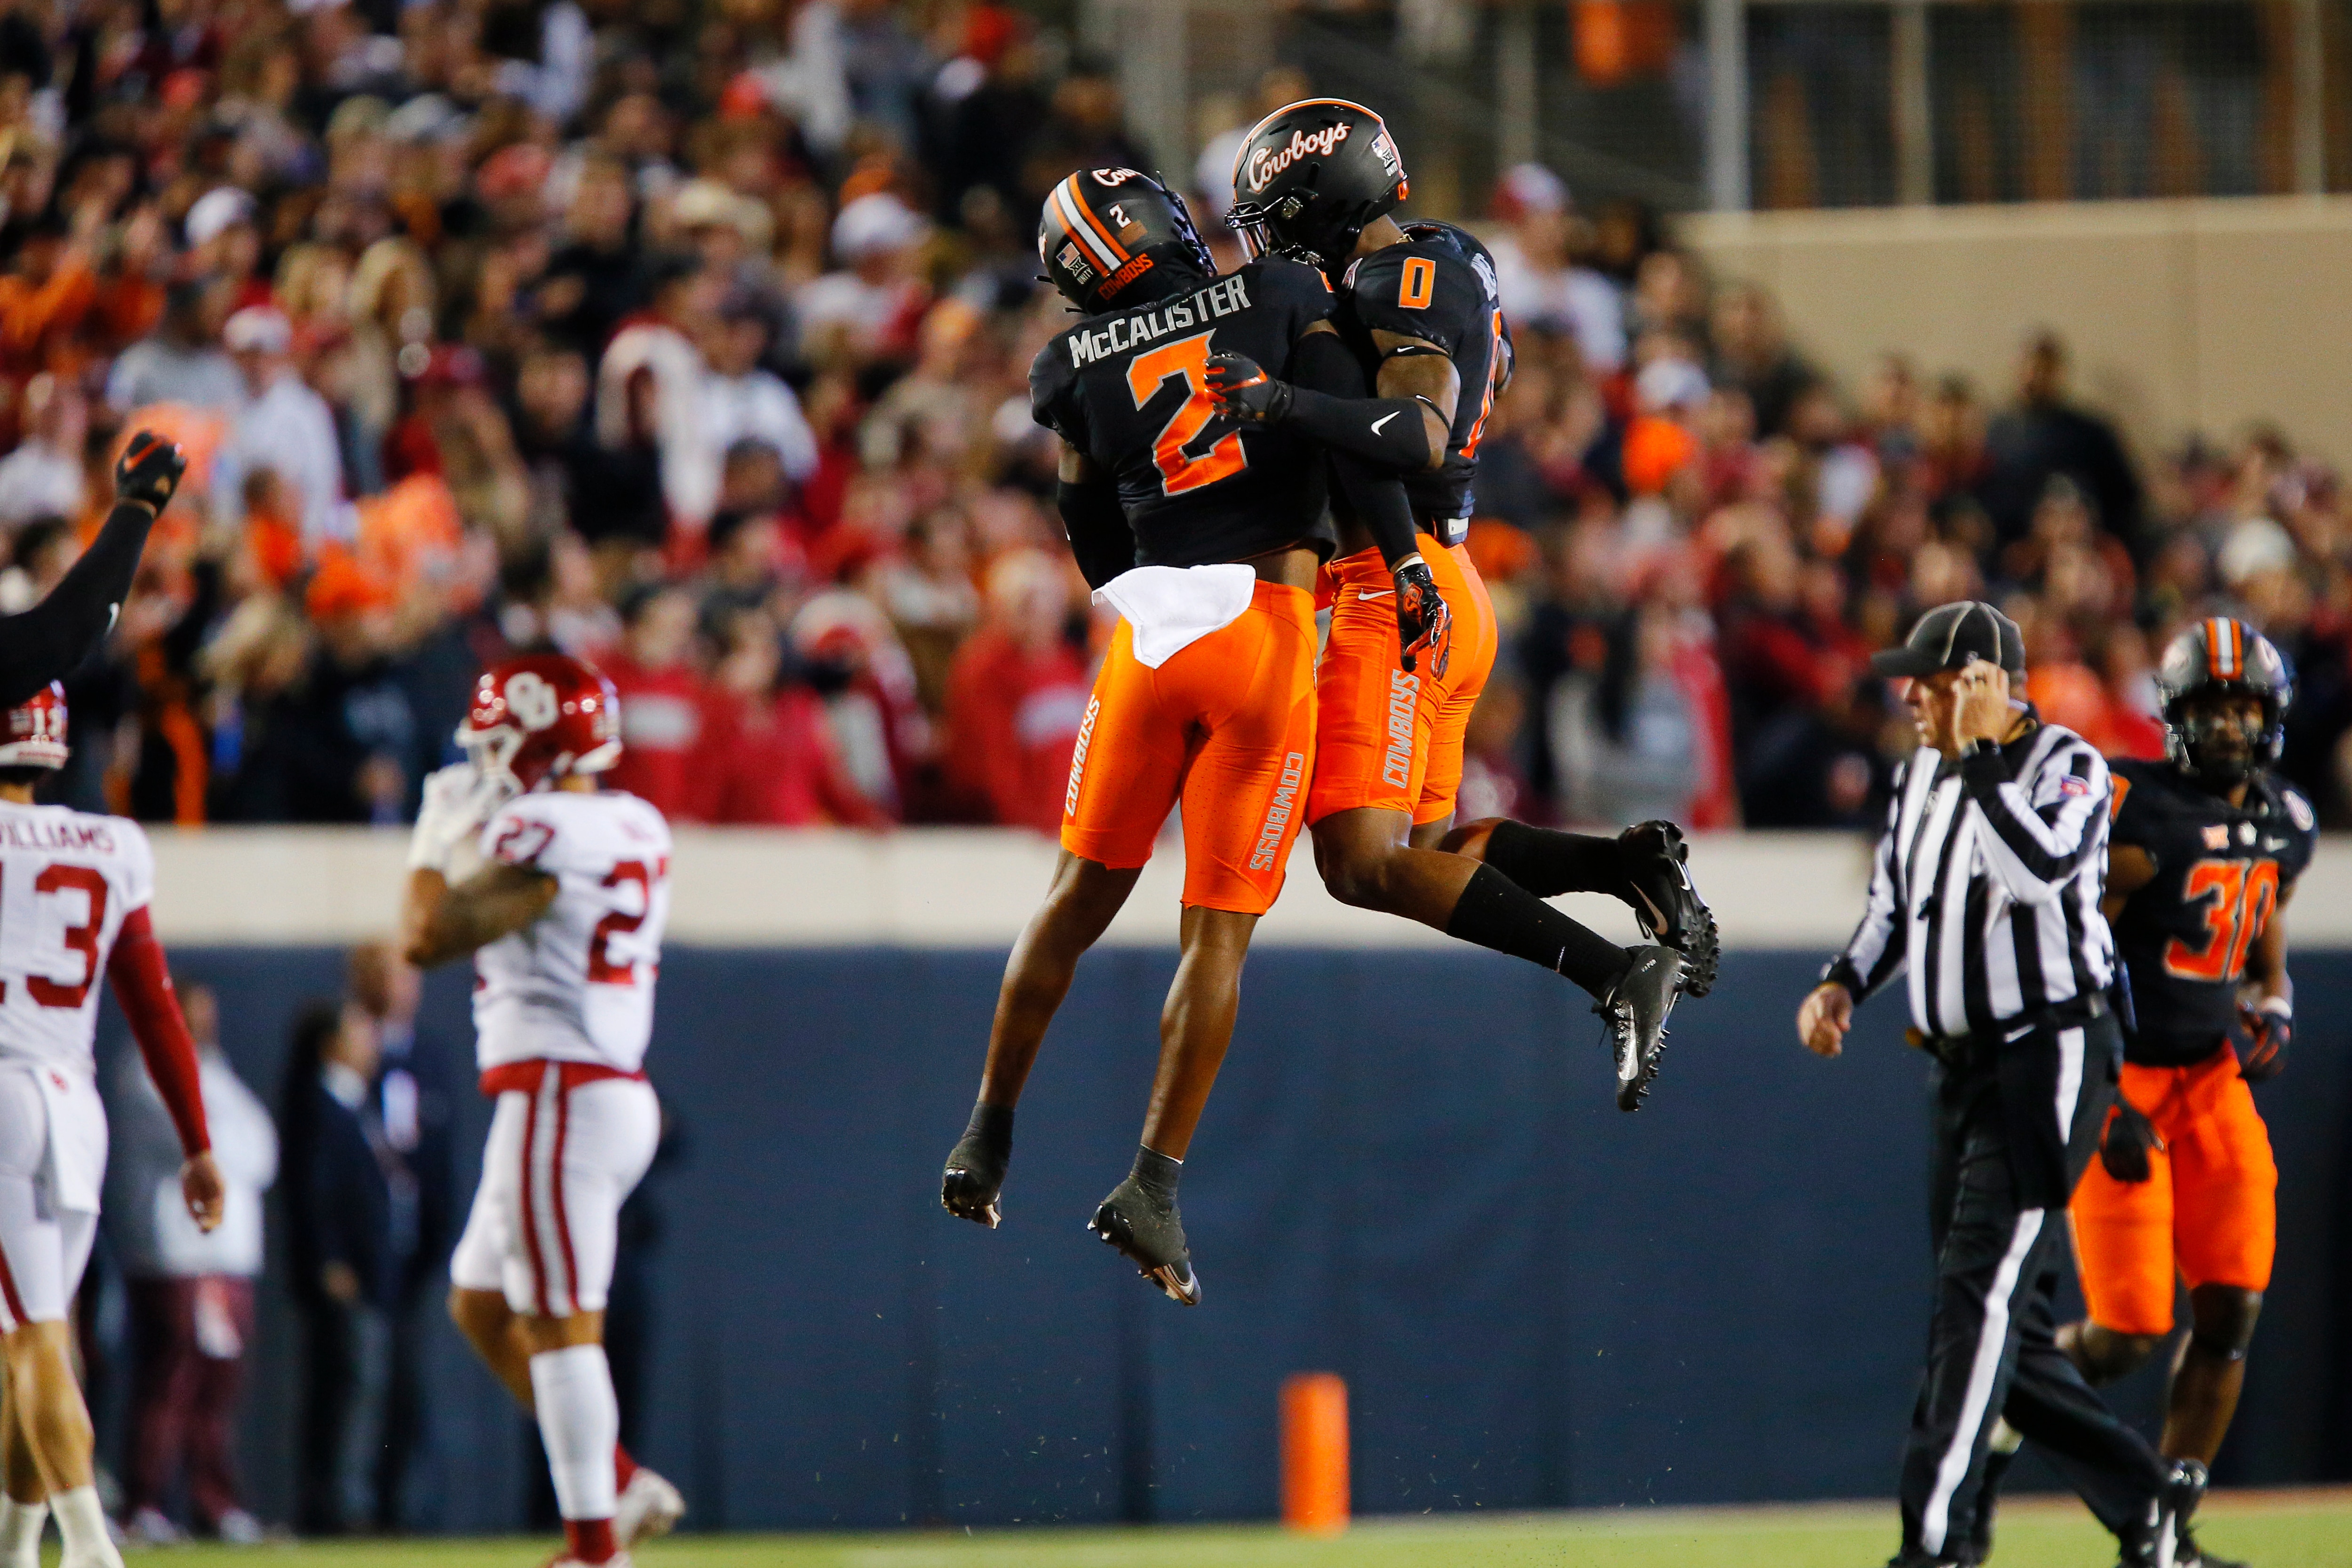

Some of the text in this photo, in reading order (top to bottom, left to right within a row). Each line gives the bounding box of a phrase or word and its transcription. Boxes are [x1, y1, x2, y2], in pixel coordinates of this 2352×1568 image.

[1248, 122, 1352, 193] Cowboys
[1109, 204, 1132, 229] 2
[1068, 274, 1252, 369] McCALISTER
[1076, 267, 1094, 285] UNITY
[1098, 253, 1154, 300] COWBOYS
[1398, 256, 1436, 310] 0
[1126, 328, 1248, 497] 2
[1065, 693, 1100, 817] COWBOYS
[1383, 669, 1420, 789] COWBOYS
[1249, 751, 1304, 871] COWBOYS
[2161, 856, 2280, 983] 30
